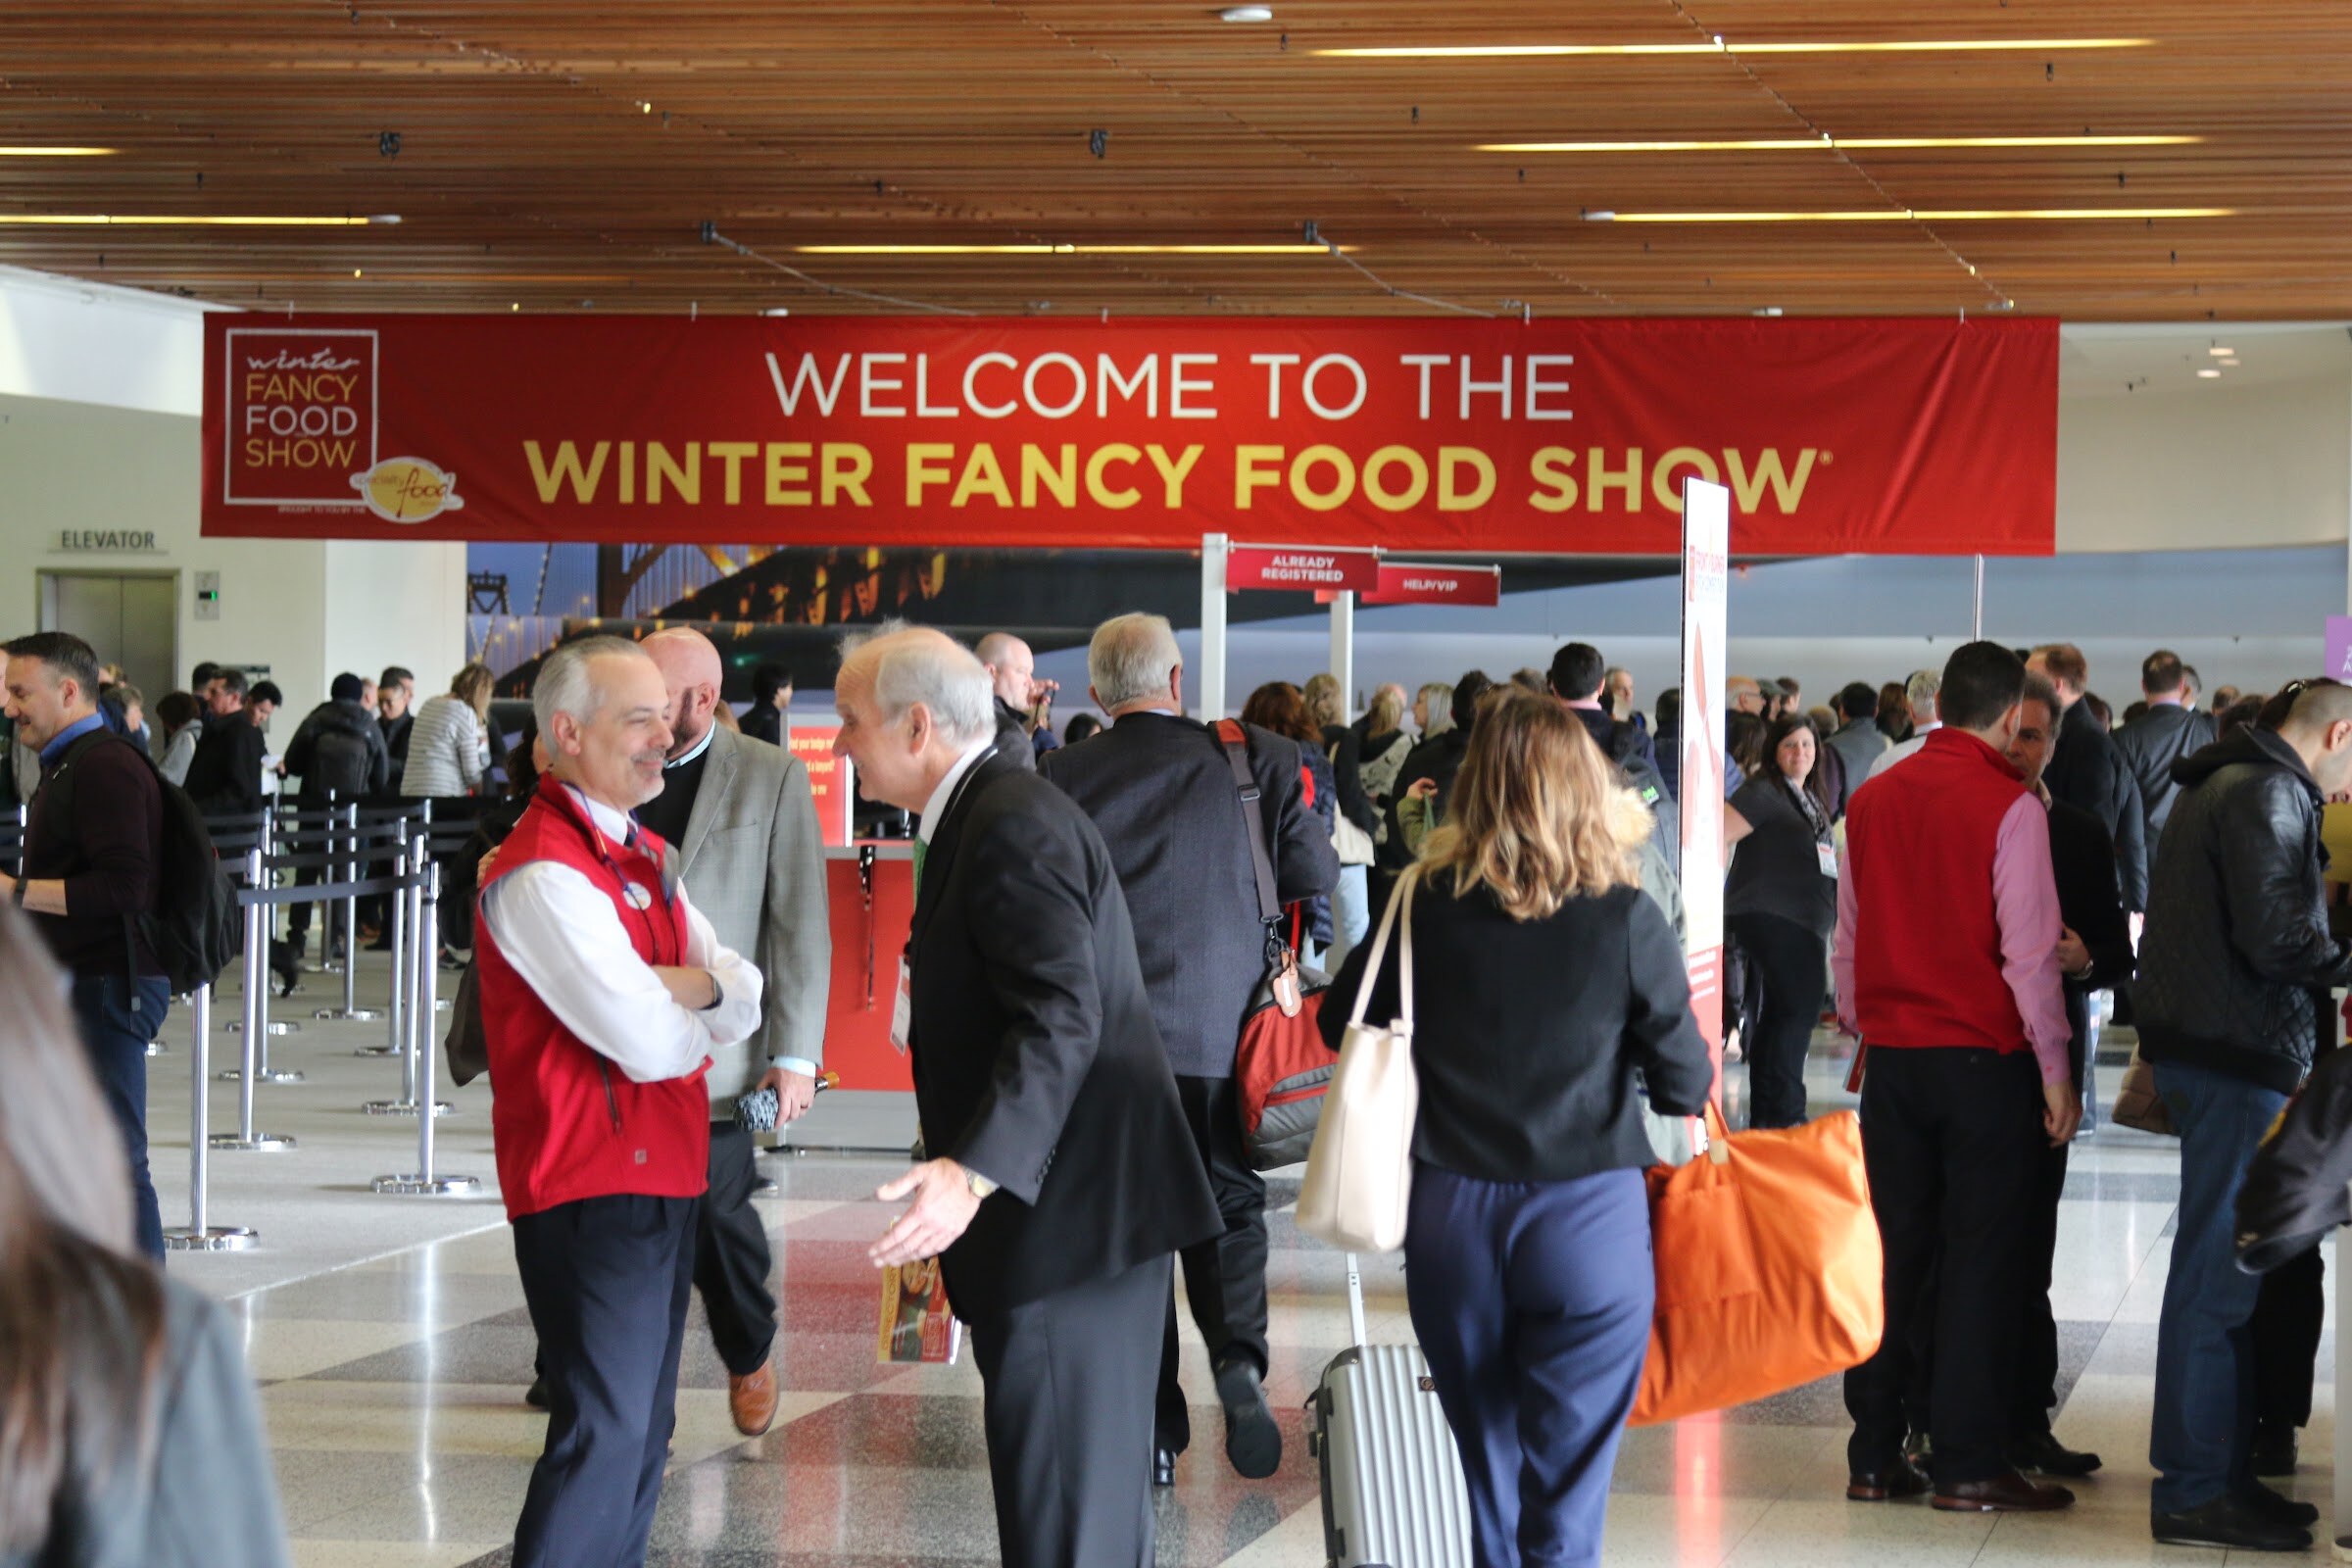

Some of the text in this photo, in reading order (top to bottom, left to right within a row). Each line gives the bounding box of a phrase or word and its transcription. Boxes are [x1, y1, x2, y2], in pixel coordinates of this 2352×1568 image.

[247, 347, 361, 370] winter
[246, 373, 359, 402] FANCY
[766, 352, 1574, 420] WELCOME TO THE
[246, 405, 359, 436] FOOD
[245, 439, 357, 468] SHOW
[524, 441, 873, 507] WINTER
[906, 443, 1205, 510] FANCY
[1235, 445, 1497, 512] FOOD
[62, 530, 155, 549] ELEVATOR
[1261, 567, 1344, 582] REGISTERED
[1271, 555, 1335, 568] ALREADY
[1402, 578, 1458, 592] HELP/VIP
